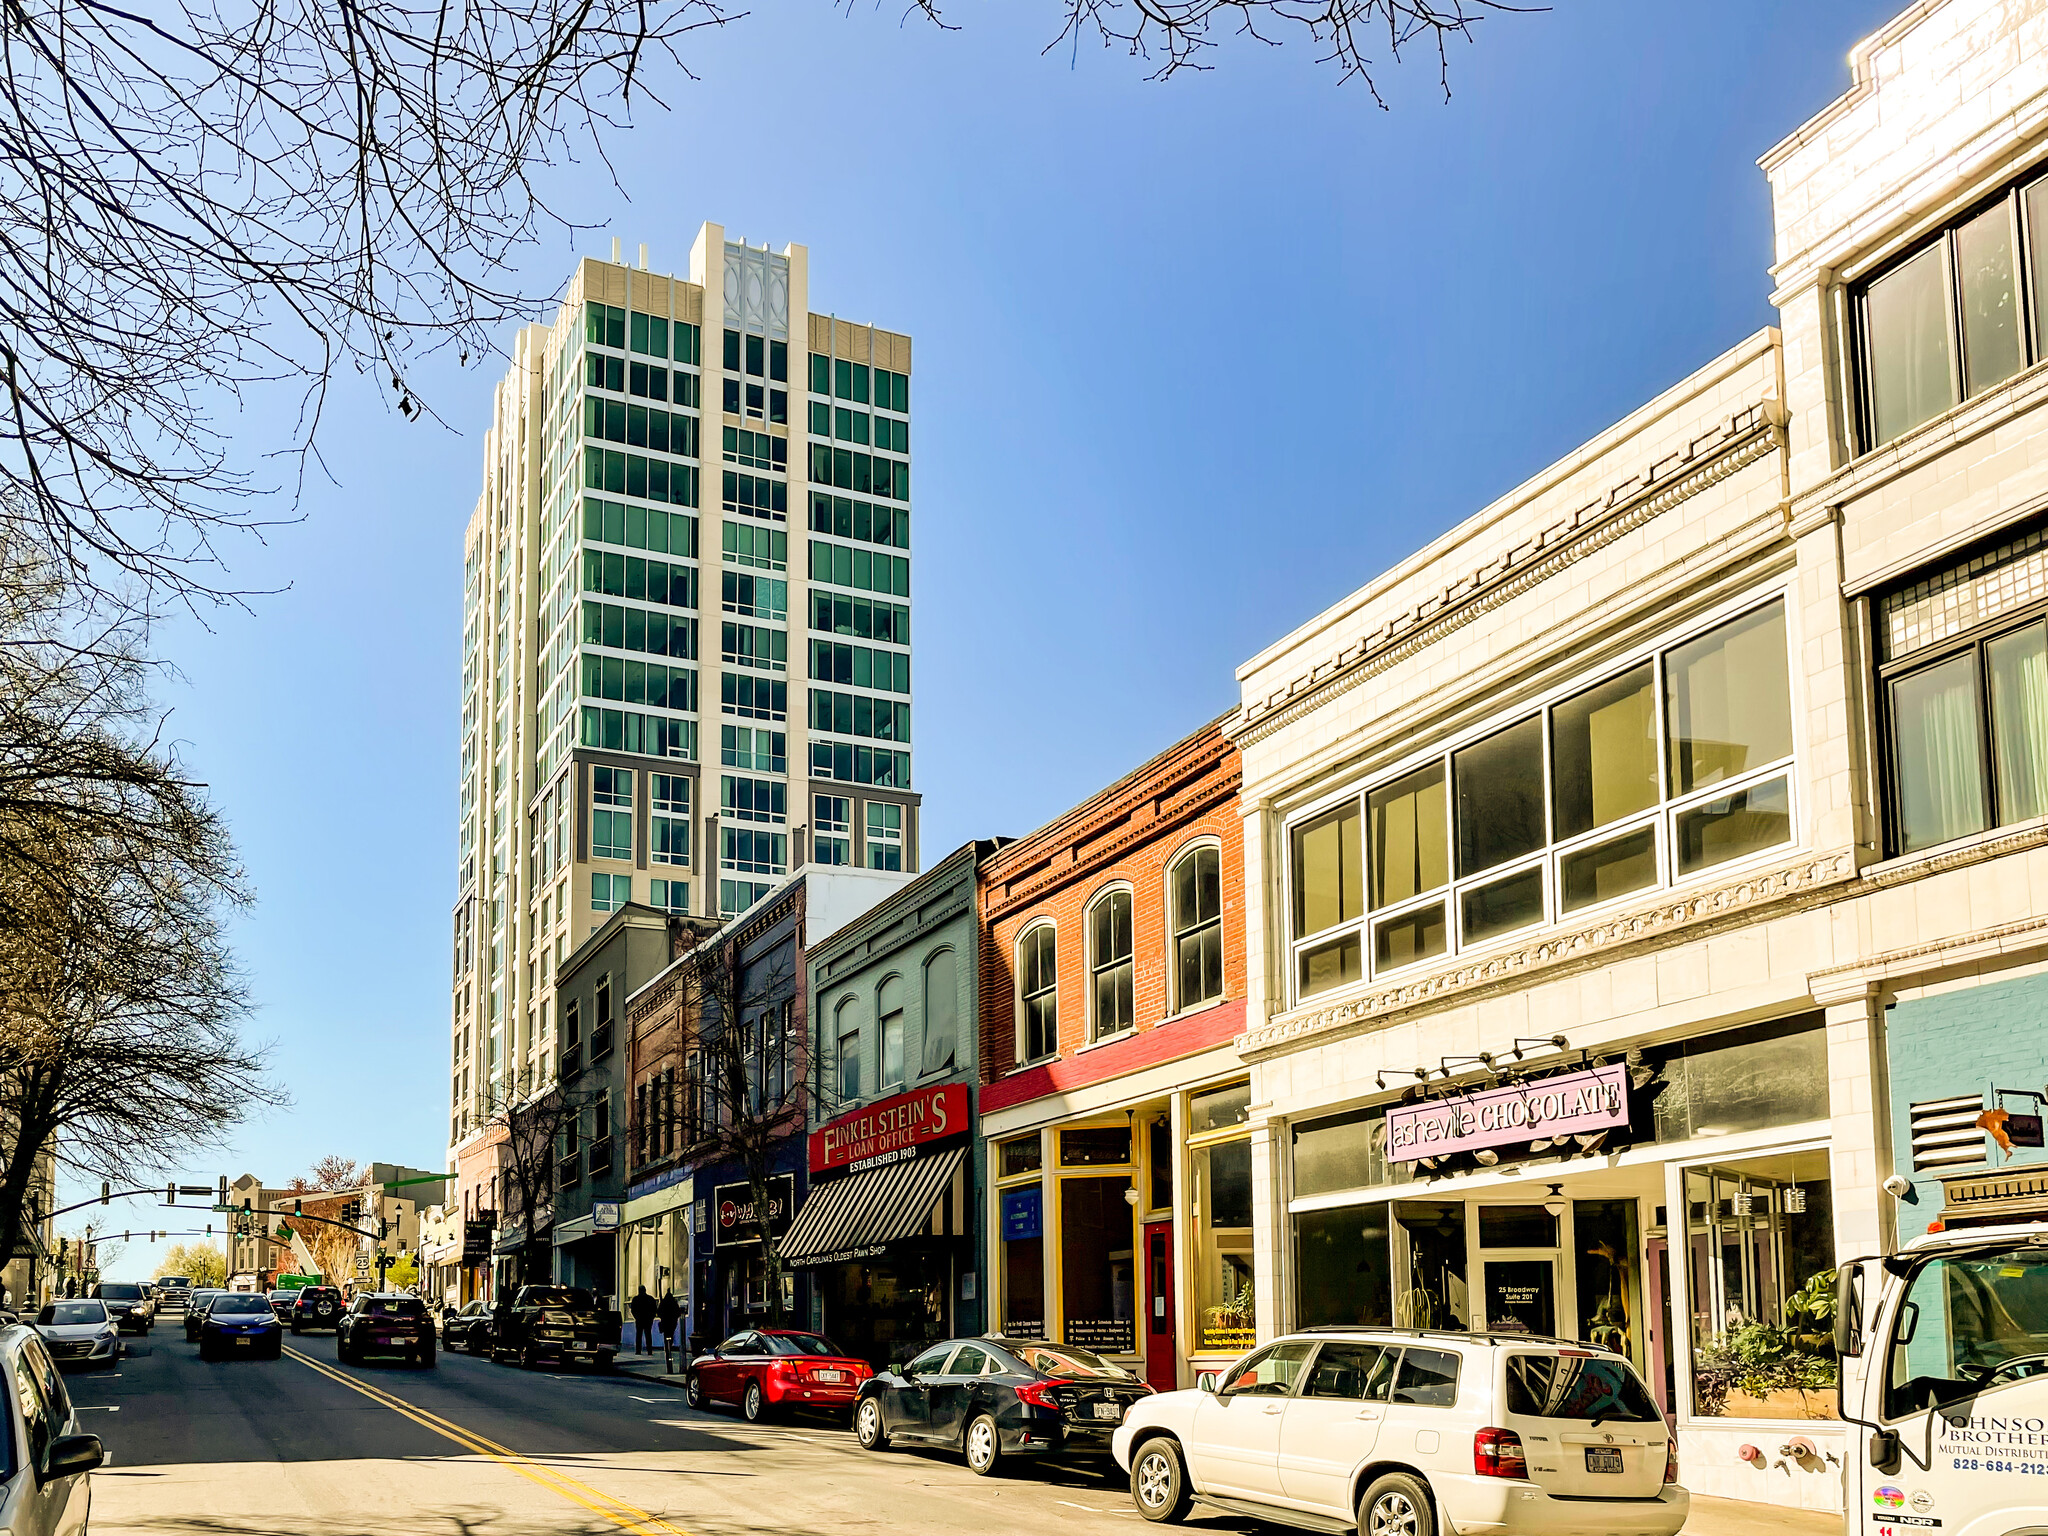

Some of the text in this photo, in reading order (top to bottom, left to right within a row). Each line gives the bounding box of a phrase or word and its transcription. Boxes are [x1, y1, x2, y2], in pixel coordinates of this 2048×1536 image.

[1393, 1082, 1622, 1147] asheville CHOCOLATE
[824, 1092, 947, 1165] FINKELSTEIN'S
[849, 1127, 915, 1159] LOAN OFFICE
[850, 1146, 916, 1172] ESTABLISHED 1903
[834, 1251, 853, 1261] OLDEST
[854, 1248, 868, 1258] PAWN
[870, 1246, 886, 1255] SHOP
[1939, 1416, 2048, 1439] JOHNSO
[1939, 1444, 1982, 1455] MUTUAL
[1953, 1458, 2048, 1475] 828-684-212
